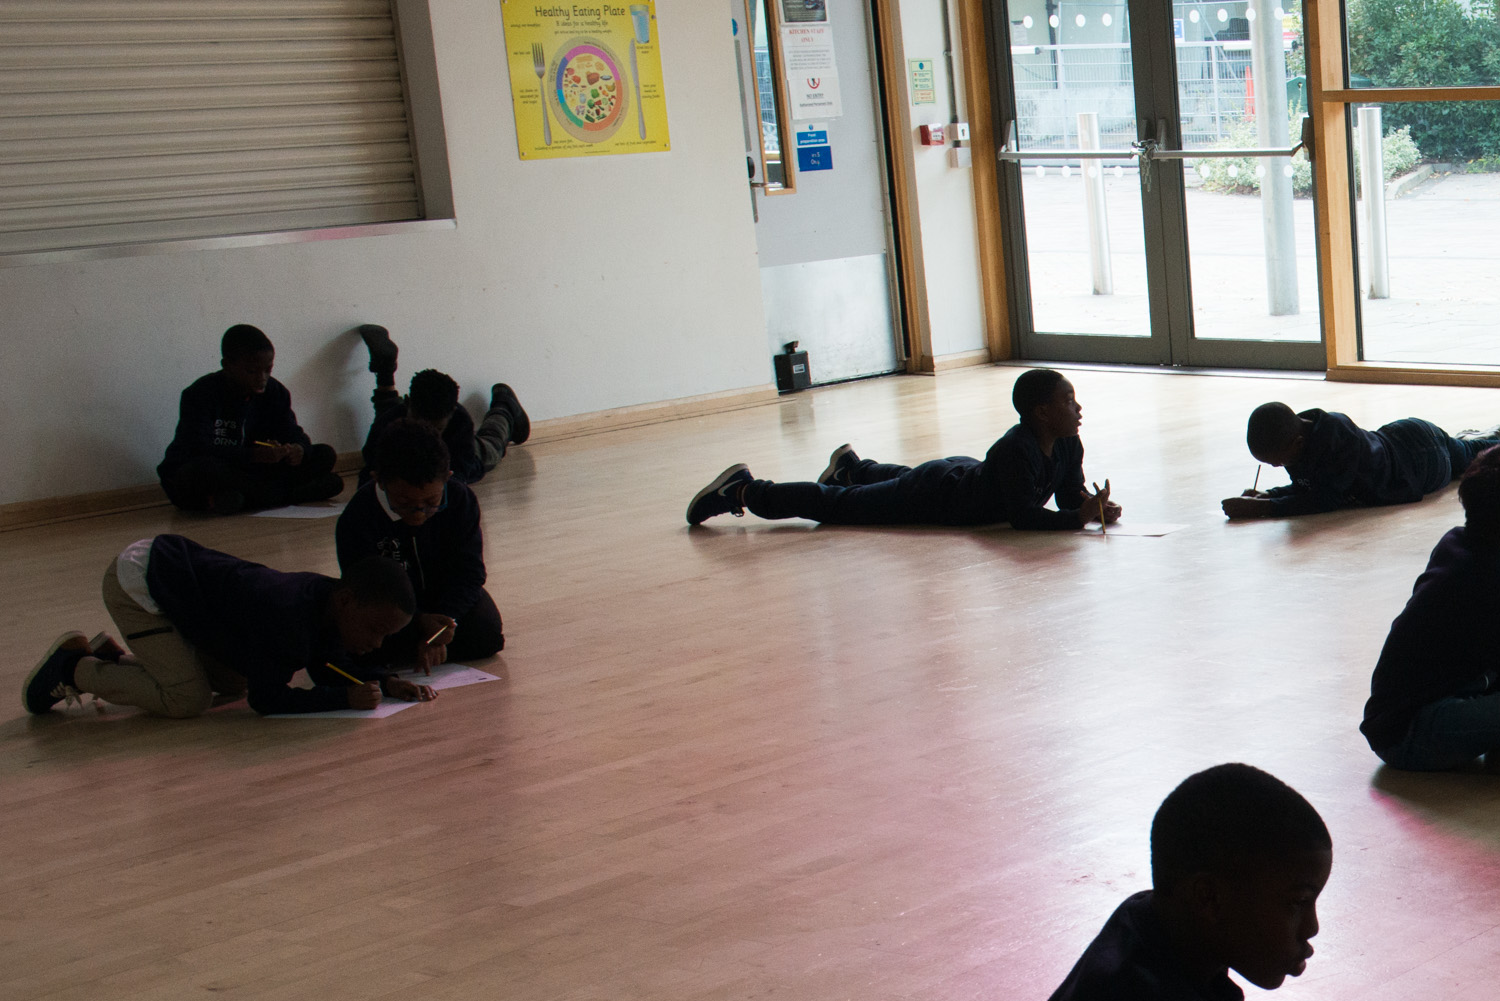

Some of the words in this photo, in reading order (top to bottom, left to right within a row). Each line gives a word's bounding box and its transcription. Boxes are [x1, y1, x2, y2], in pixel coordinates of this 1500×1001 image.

[535, 5, 570, 20] Healthy
[572, 5, 601, 19] Eating
[603, 4, 625, 16] Plate
